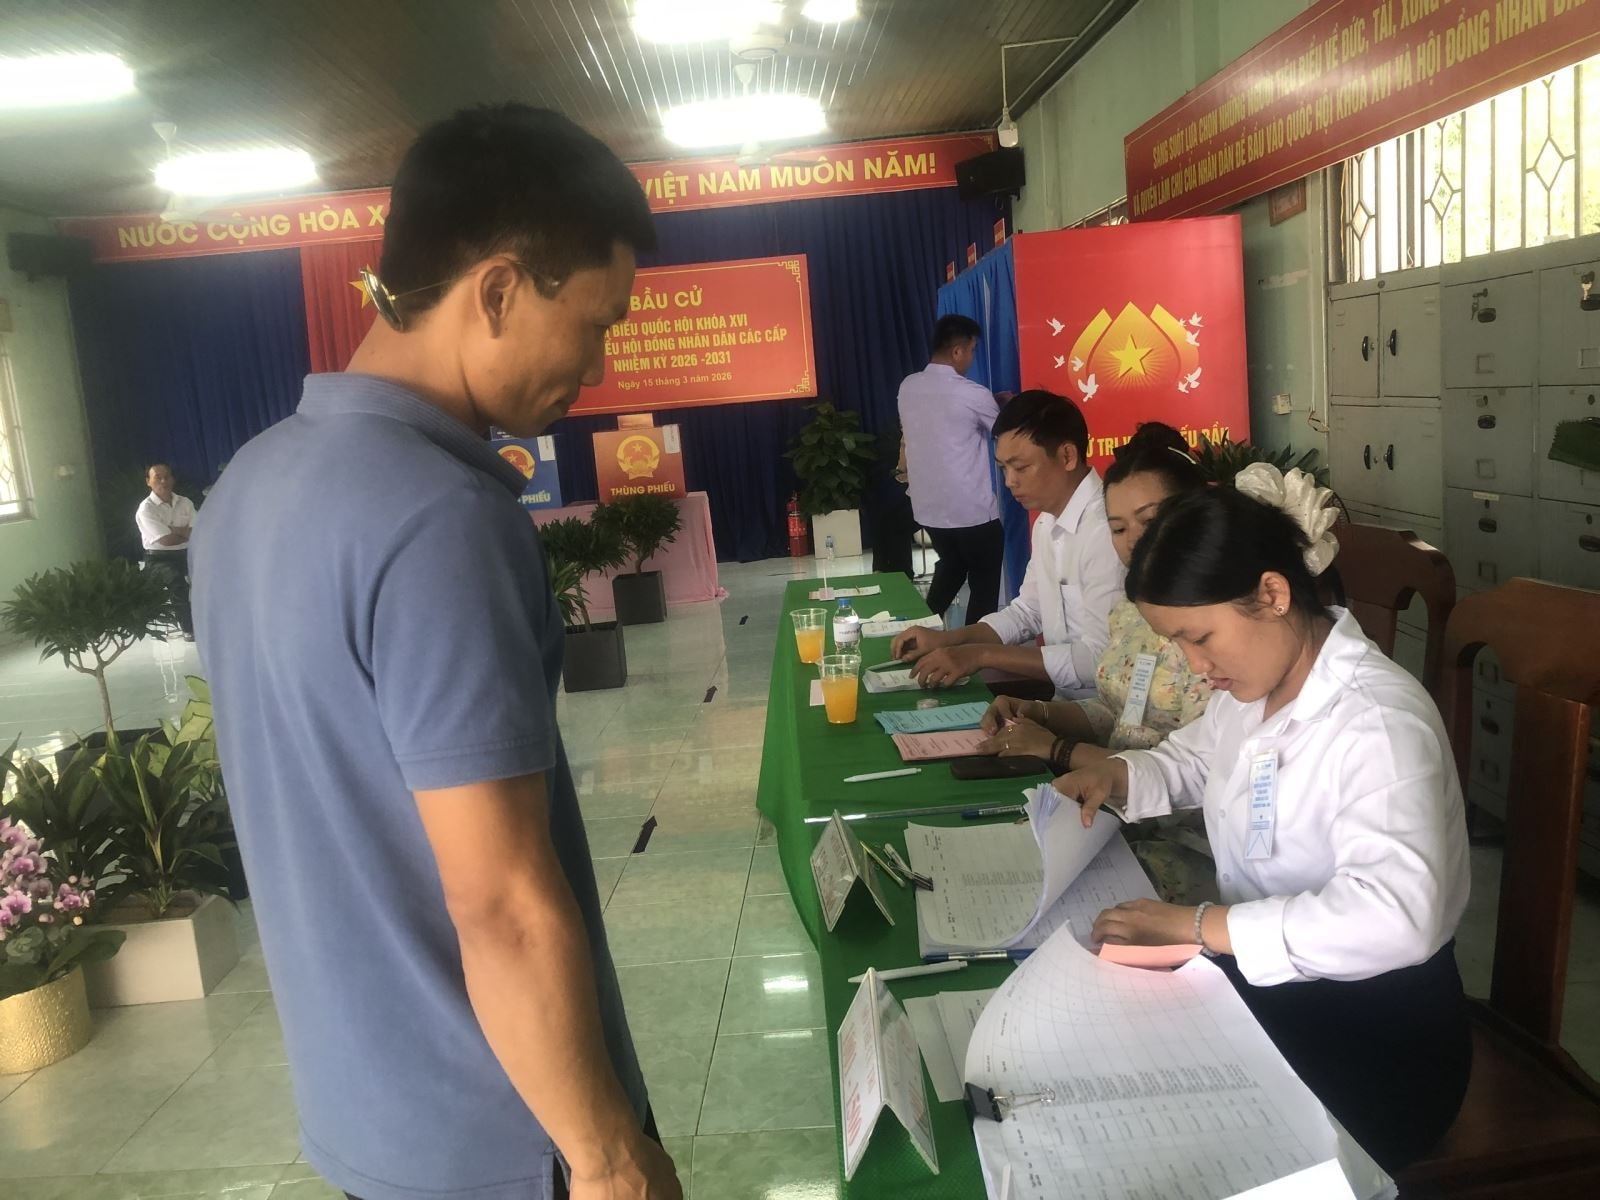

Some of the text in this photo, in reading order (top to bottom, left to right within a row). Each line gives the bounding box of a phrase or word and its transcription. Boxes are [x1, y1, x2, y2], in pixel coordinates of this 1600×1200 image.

[1286, 100, 1313, 147] QUỐC
[1315, 87, 1333, 135] HỘI
[1371, 60, 1391, 104] XVI
[1395, 43, 1413, 92] VÀ
[1416, 30, 1441, 86] HỘI
[1445, 7, 1490, 68] ĐỒNG
[207, 212, 291, 246] CỘNG
[299, 204, 360, 233] HÒA
[367, 205, 385, 227] X
[698, 168, 761, 195] NAM
[770, 158, 854, 188] MUÔN
[863, 150, 936, 179] NĂM!
[629, 285, 703, 311] BẦU CỬ
[612, 318, 638, 338] BIỂU
[641, 315, 671, 336] QUỐC
[674, 315, 692, 335] HỘI
[696, 313, 727, 331] KHÓA
[729, 313, 748, 328] XVI
[623, 338, 641, 356] HỘI
[644, 335, 675, 352] ĐỒNG
[678, 333, 709, 349] NHÂN
[713, 331, 737, 347] DÂN
[739, 328, 762, 344] CÁC
[764, 323, 787, 343] CẤP
[613, 355, 650, 374] NHIỆM
[671, 353, 697, 368] 2026
[701, 351, 731, 365] -2031
[617, 380, 640, 390] Ngày
[643, 379, 654, 387] 15
[655, 377, 681, 387] tháng
[690, 373, 709, 382] năm
[711, 372, 732, 381] 2026
[1098, 436, 1118, 457] TRI
[521, 489, 551, 504] PHIẾU
[610, 480, 676, 496] THÙNG PHIẾU
